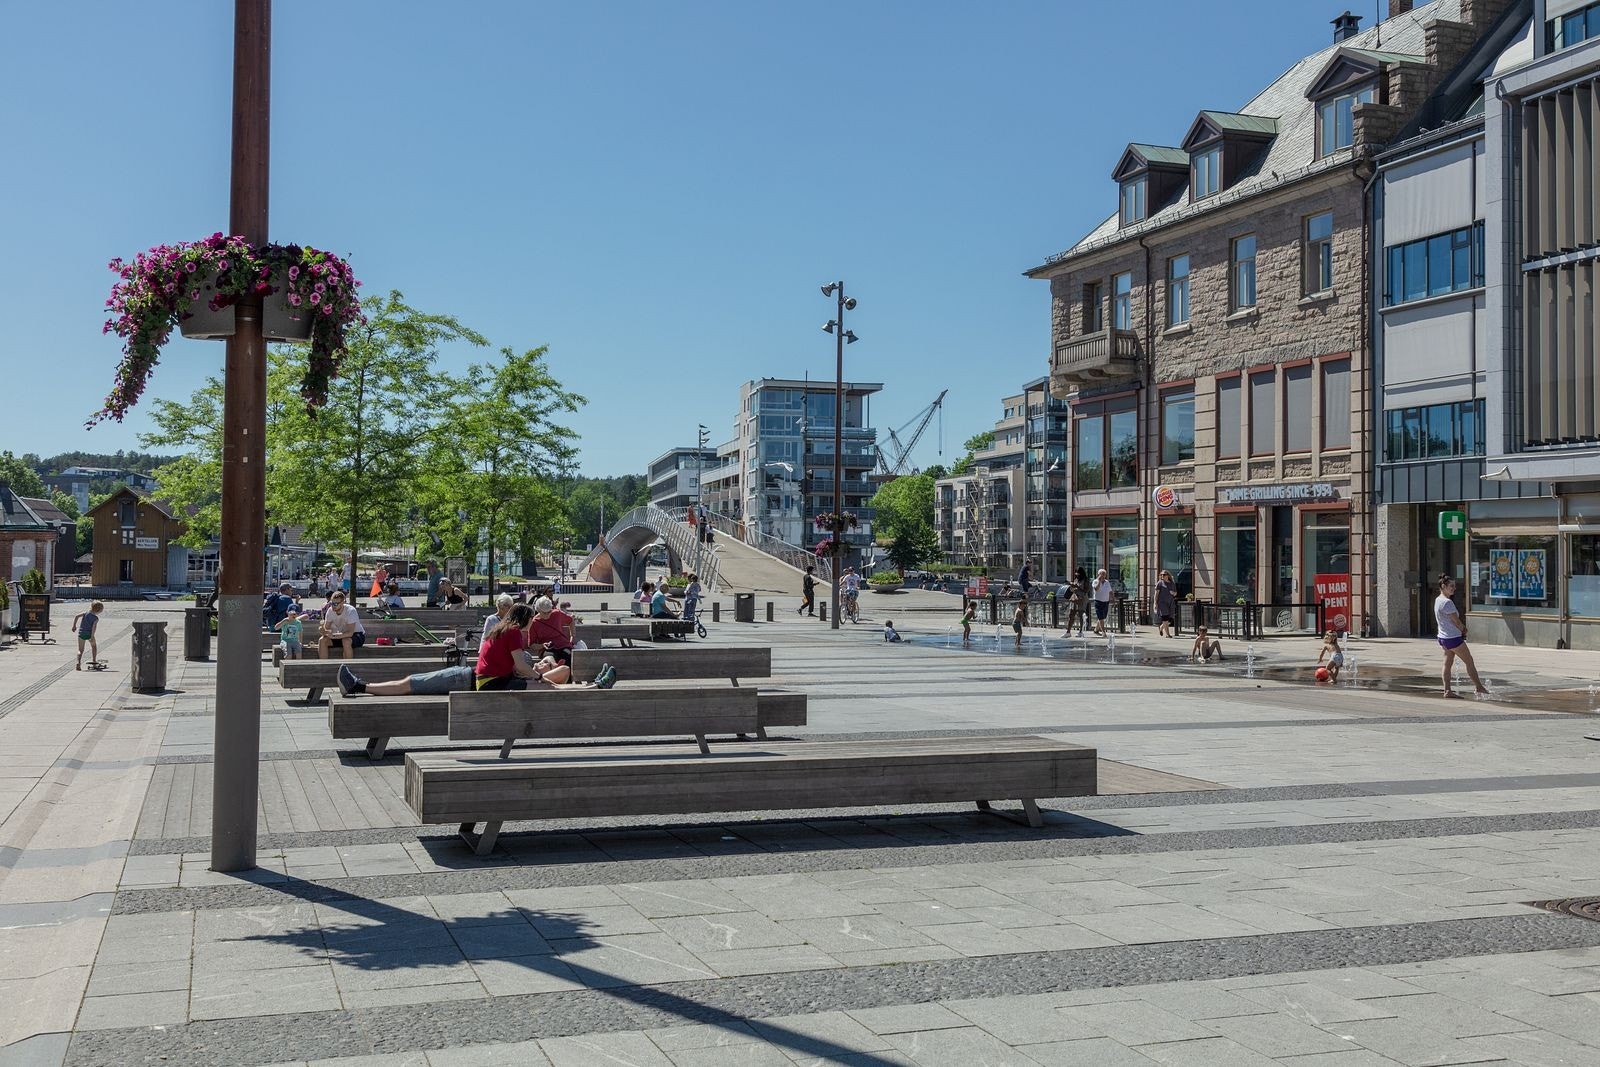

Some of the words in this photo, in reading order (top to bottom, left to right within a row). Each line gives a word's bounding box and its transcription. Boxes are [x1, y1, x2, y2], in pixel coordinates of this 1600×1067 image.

[1250, 486, 1284, 499] GRILLING
[1286, 485, 1310, 498] SINCE
[1311, 484, 1332, 497] 1954
[1316, 584, 1326, 594] VI
[1328, 583, 1347, 593] HAR
[1321, 596, 1347, 608] PENT
